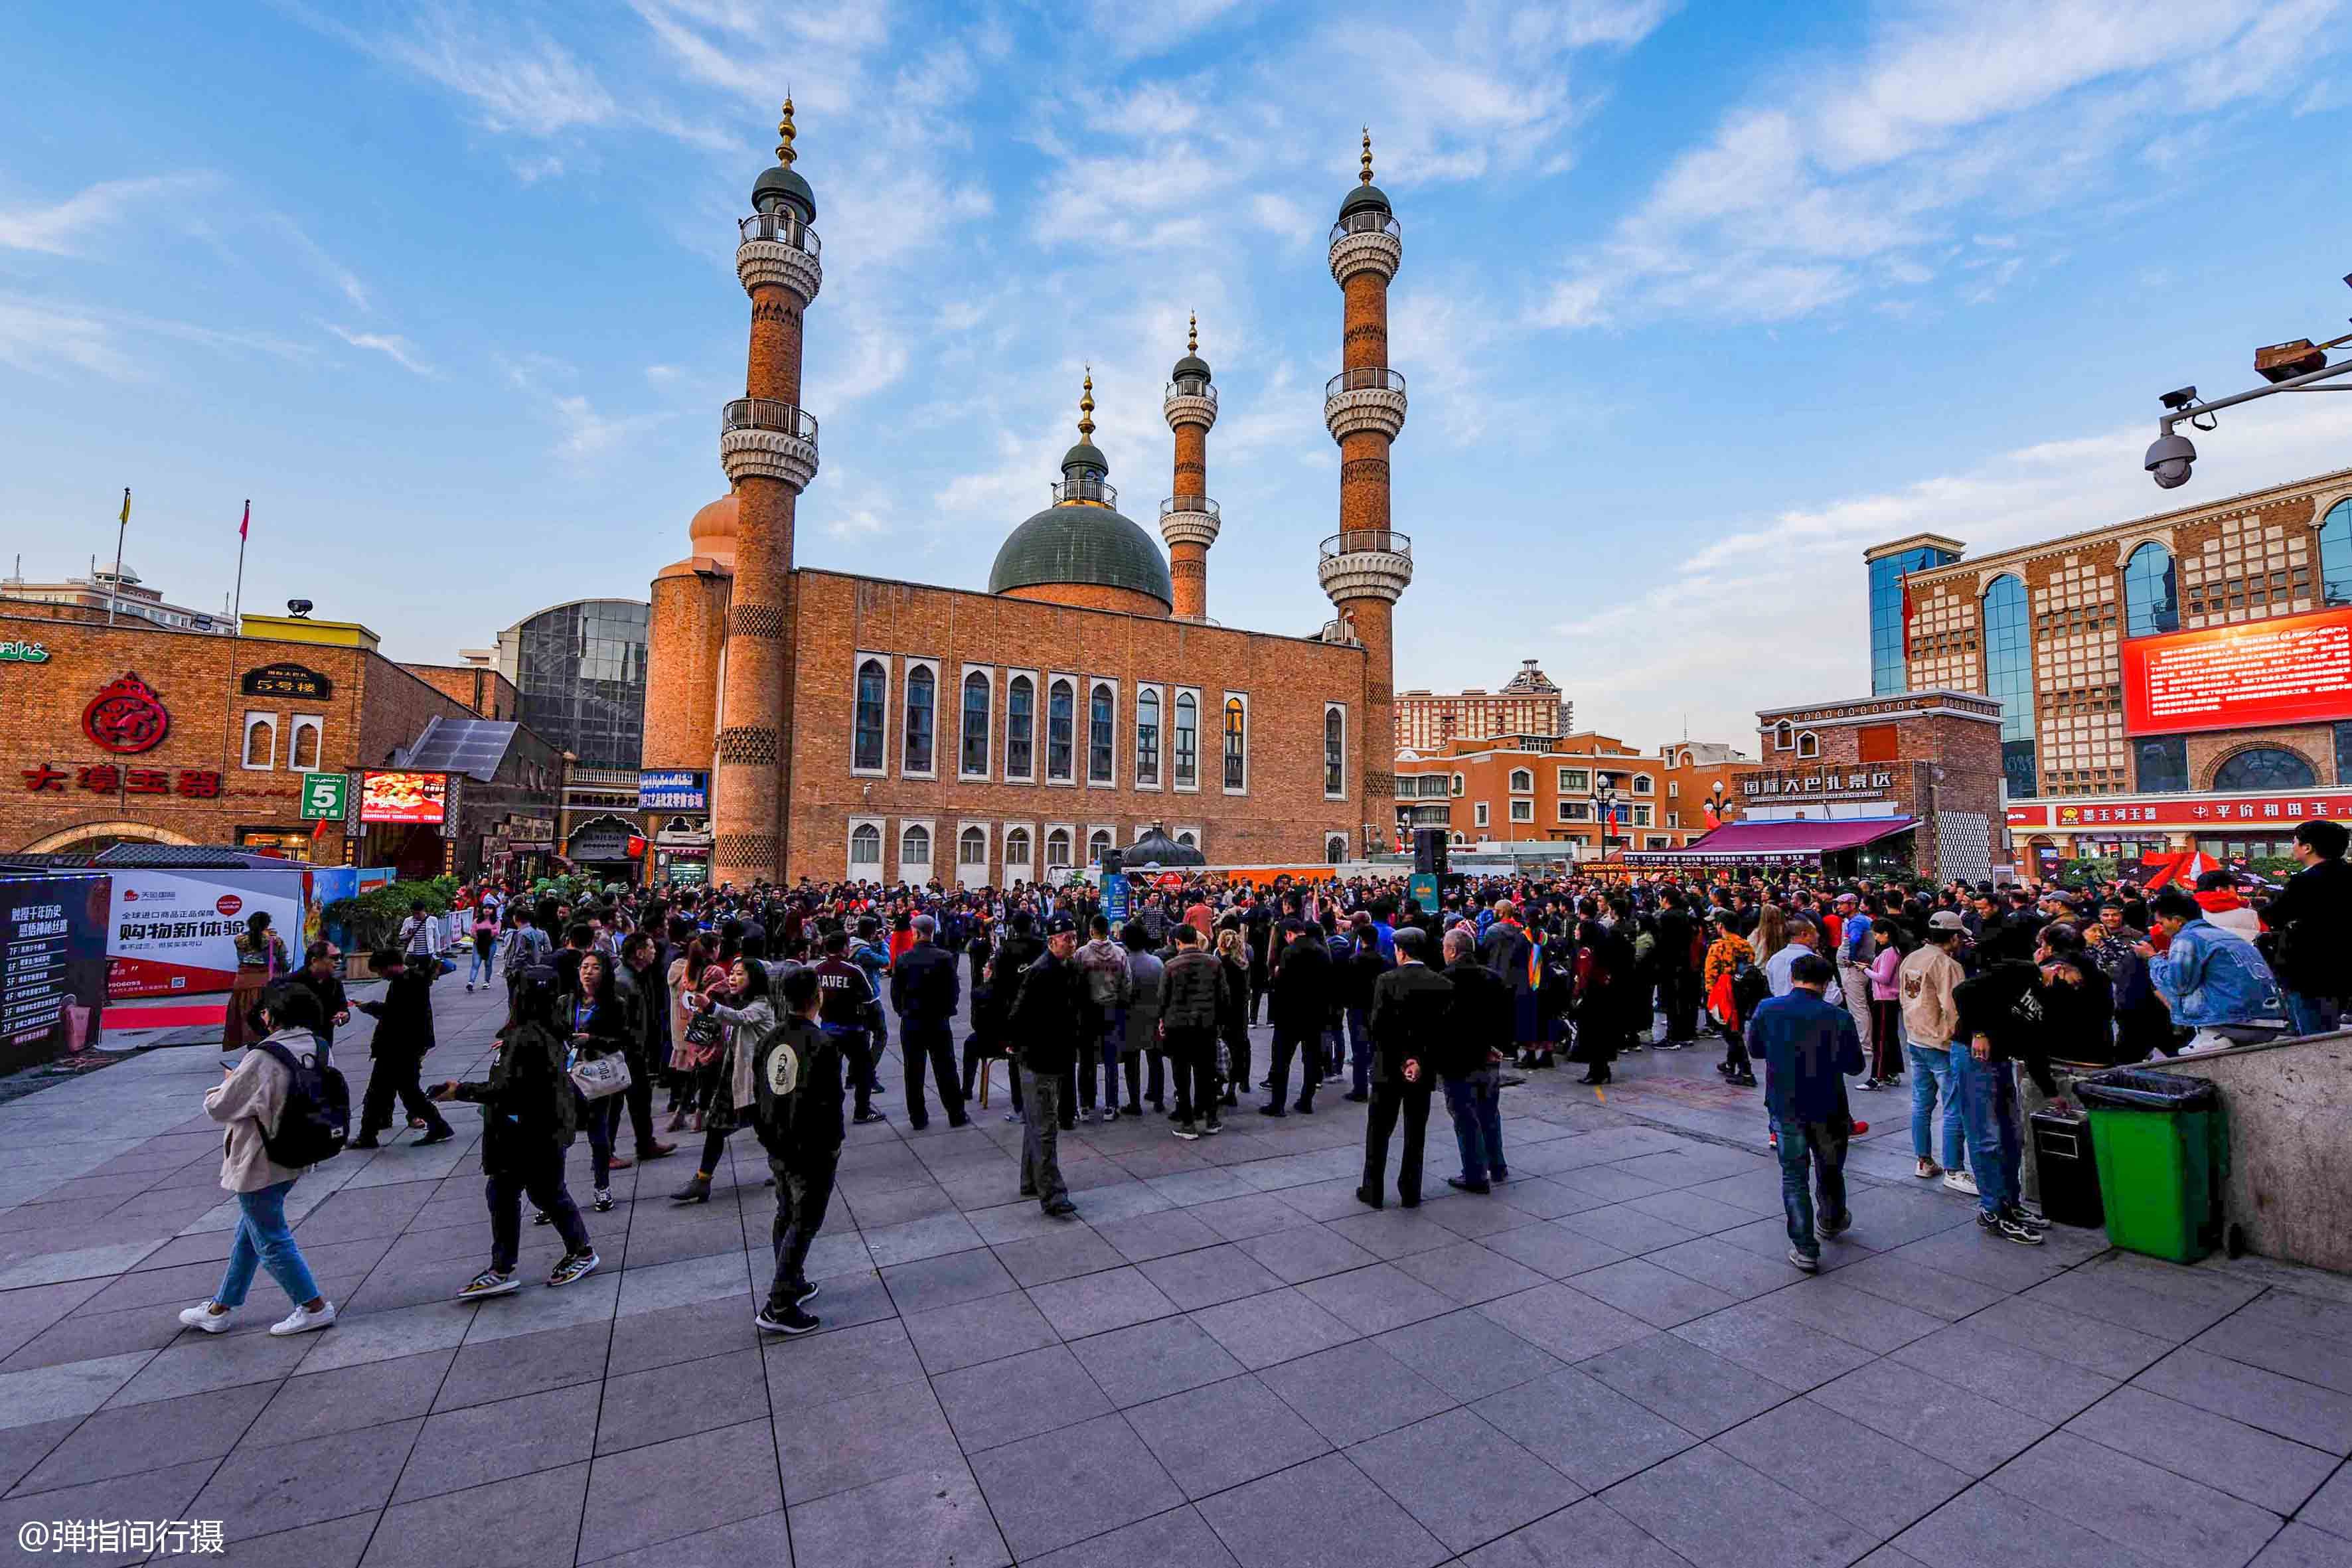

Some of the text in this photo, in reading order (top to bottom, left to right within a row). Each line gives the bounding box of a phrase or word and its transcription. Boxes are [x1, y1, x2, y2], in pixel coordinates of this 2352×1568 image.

[255, 679, 317, 692] 5号楼
[1744, 772, 1891, 795] 国际大巴扎景区
[311, 785, 337, 808] 5
[2083, 807, 2157, 822] 墨玉河玉器
[2215, 802, 2329, 818] 平价和田玉
[121, 909, 214, 920] 全球进口商品正品保障
[119, 920, 246, 941] 购物新体验
